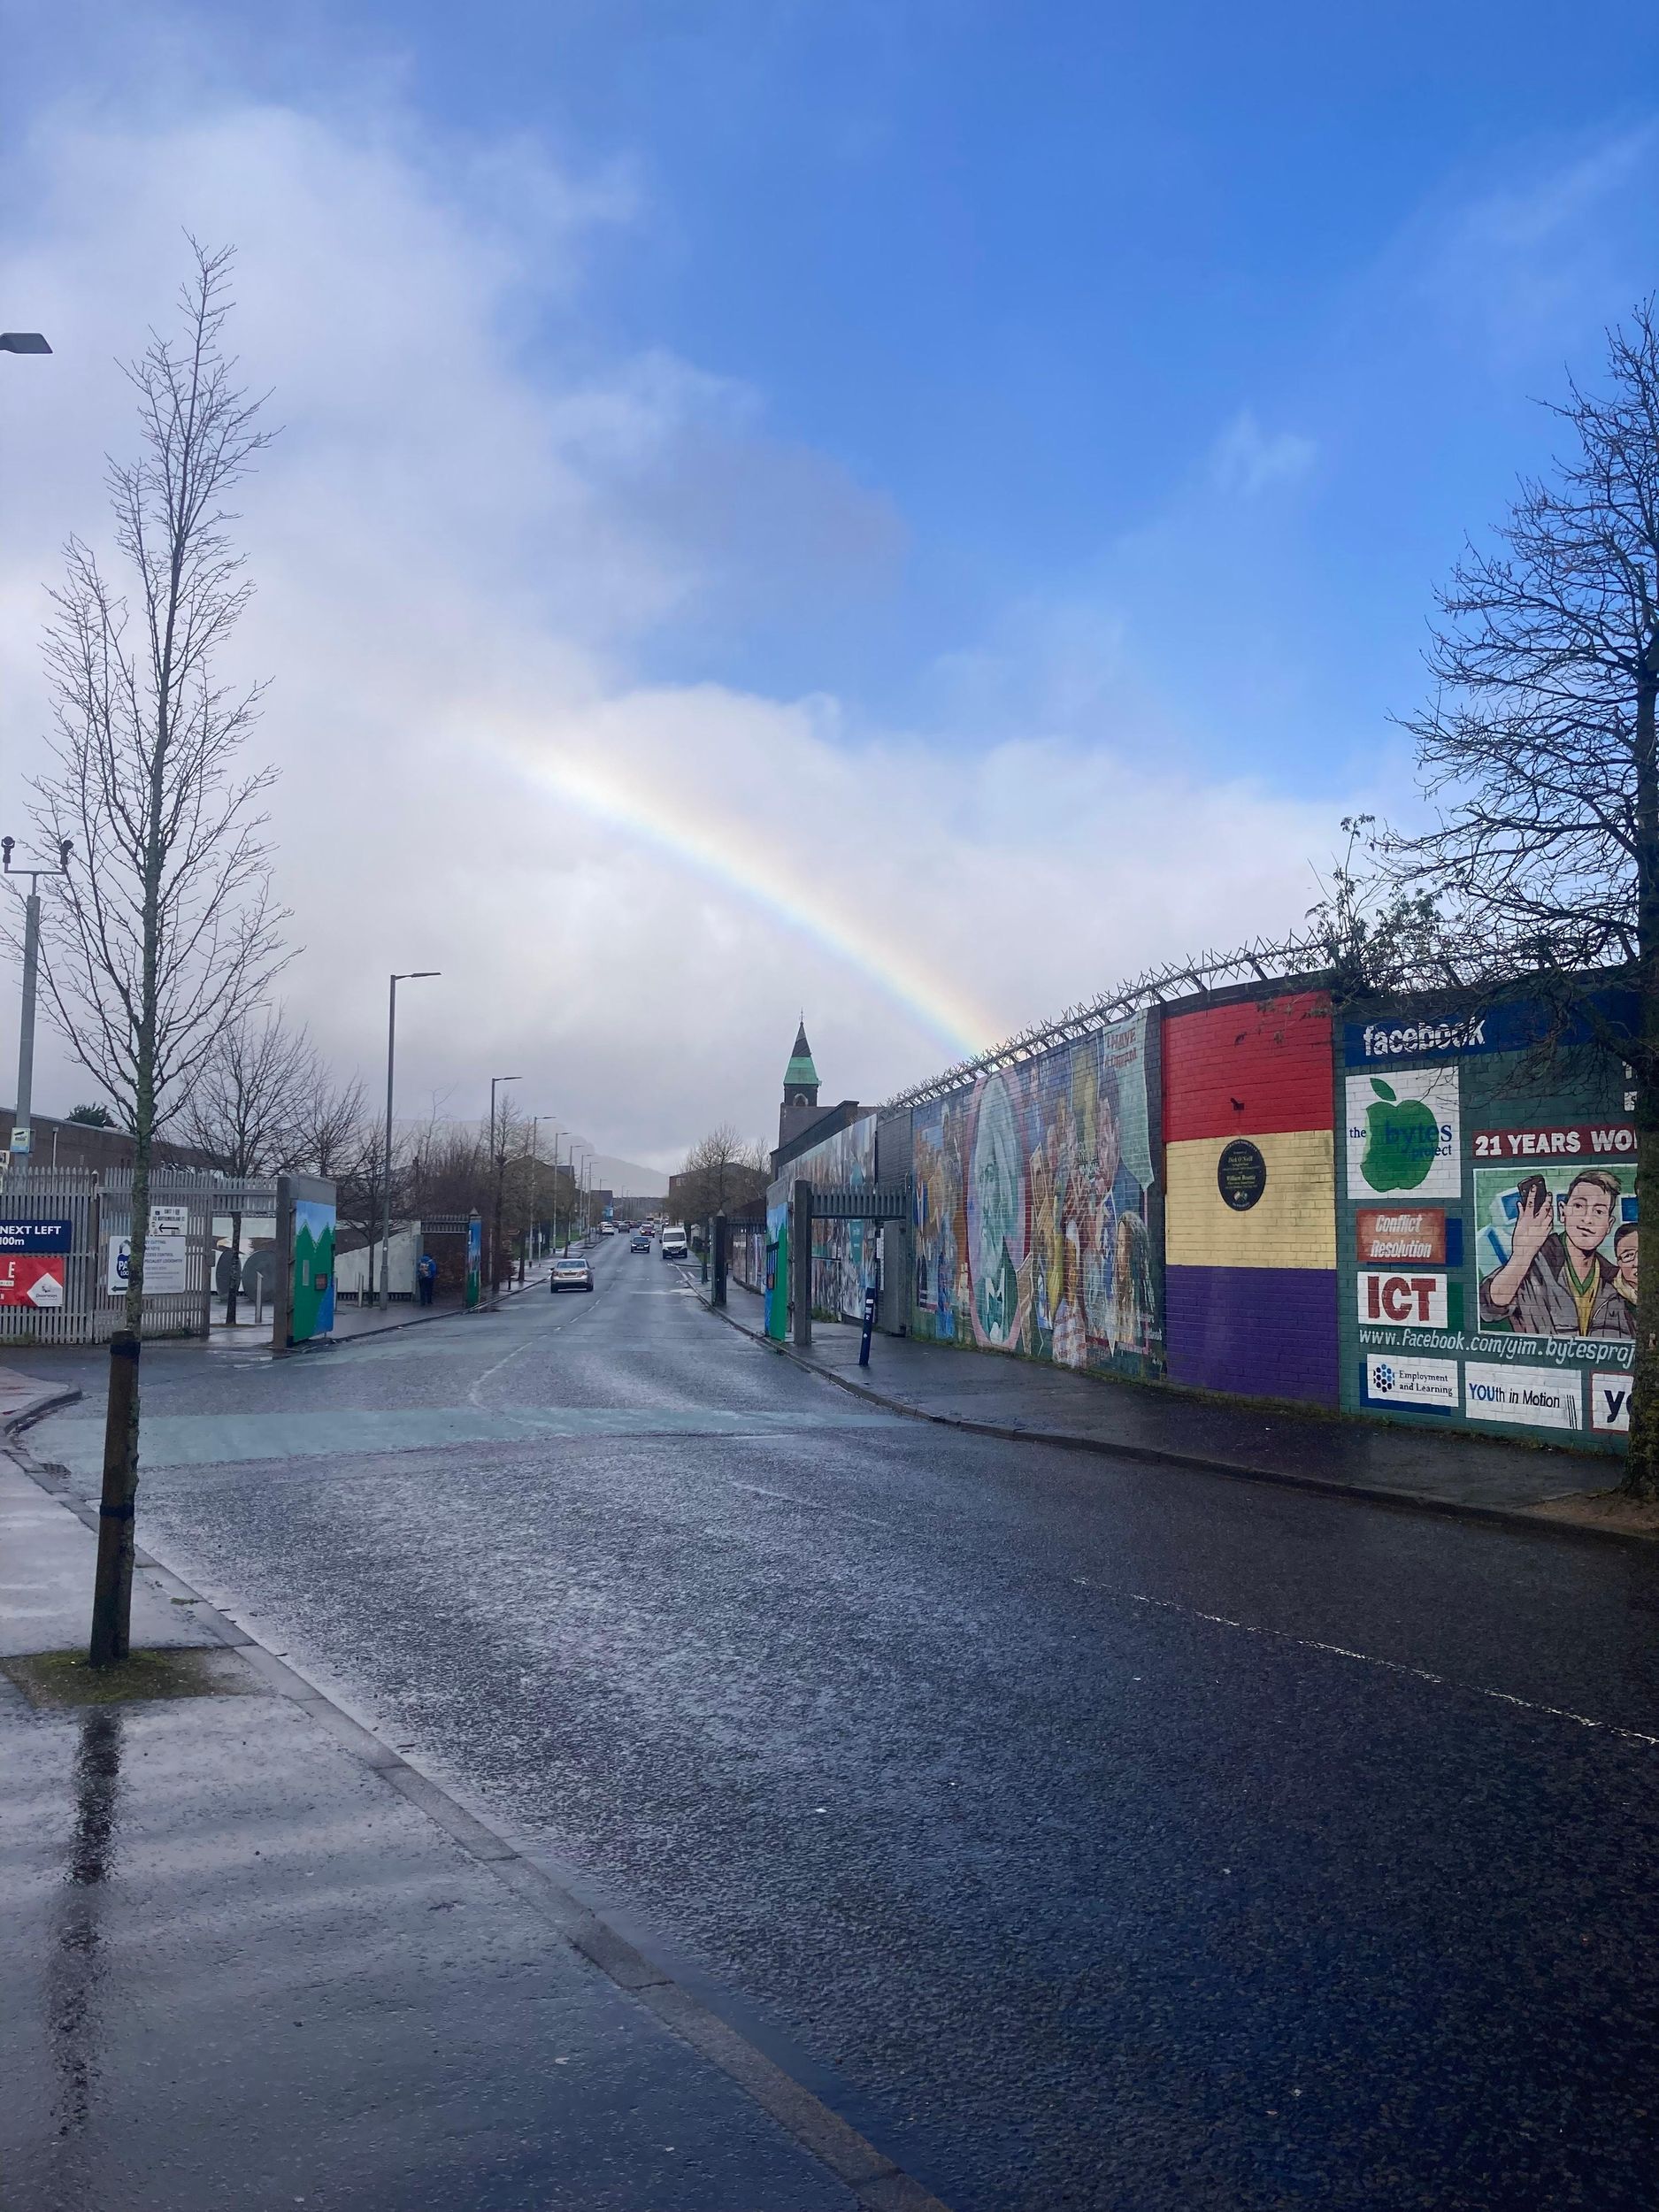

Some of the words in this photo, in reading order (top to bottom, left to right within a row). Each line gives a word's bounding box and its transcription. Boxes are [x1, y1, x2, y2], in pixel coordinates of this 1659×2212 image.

[1363, 1017, 1486, 1056] facebook
[1349, 1126, 1367, 1138] the
[1385, 1118, 1453, 1153] bytes
[1410, 1144, 1452, 1162] project
[1475, 1135, 1502, 1156] 21
[1508, 1131, 1581, 1155] YEARS
[0, 1225, 32, 1234] NEXT
[35, 1225, 62, 1234] LEFT
[1376, 1214, 1423, 1233] Conflict
[1371, 1240, 1432, 1258] Resolution
[1368, 1276, 1436, 1321] ICT
[1360, 1328, 1636, 1369] www.facebook.com/yim.bytesproj
[1399, 1370, 1448, 1382] Employment
[1417, 1383, 1453, 1396] Learning
[1469, 1383, 1504, 1402] YOUth
[1509, 1388, 1518, 1403] in
[1523, 1389, 1560, 1409] Motion
